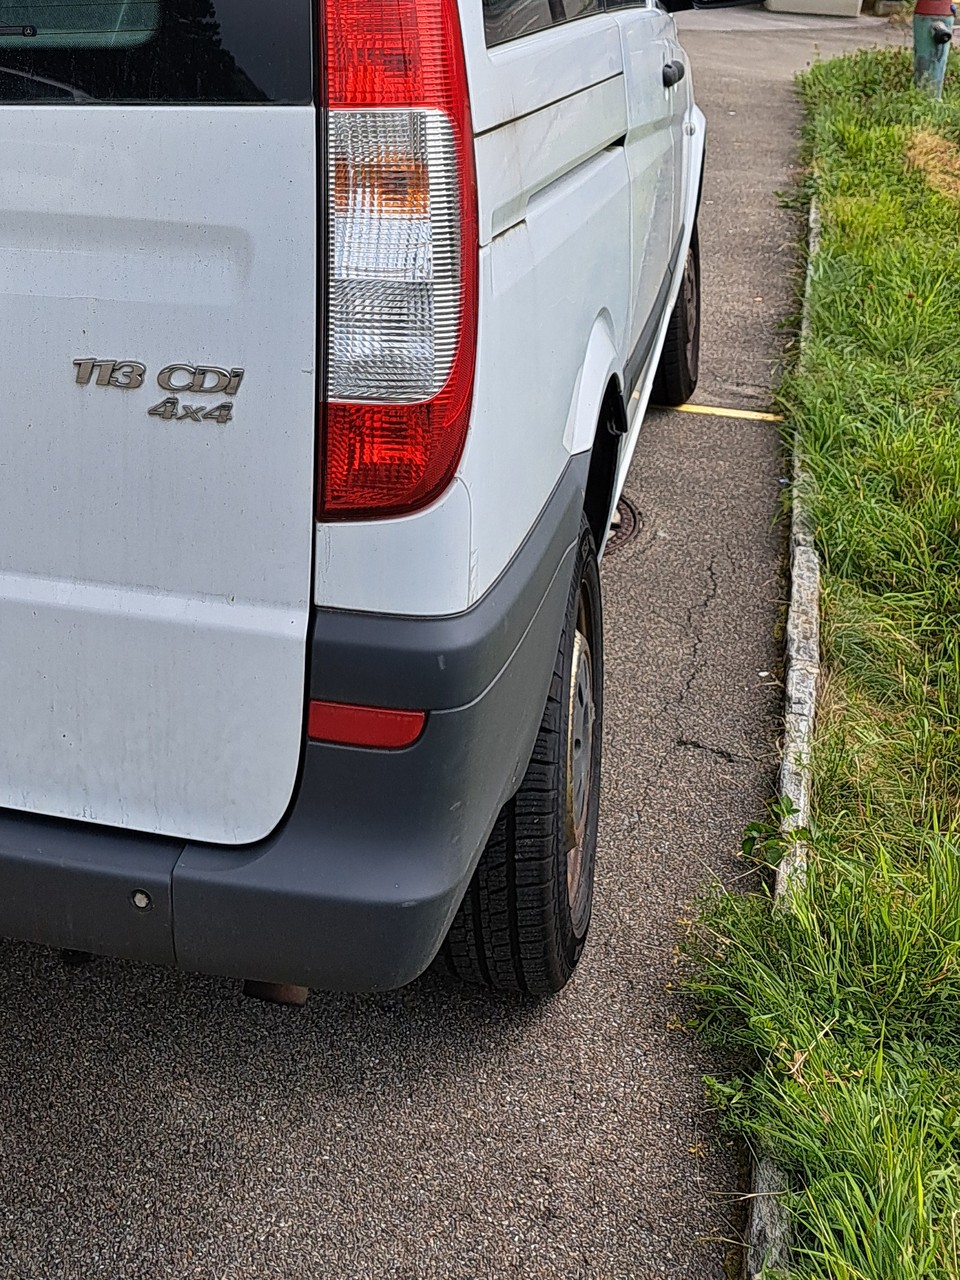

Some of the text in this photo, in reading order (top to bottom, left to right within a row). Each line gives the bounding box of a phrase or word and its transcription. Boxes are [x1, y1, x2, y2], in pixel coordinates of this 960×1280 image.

[73, 357, 245, 395] 113 CDI
[148, 396, 233, 424] 4x4
